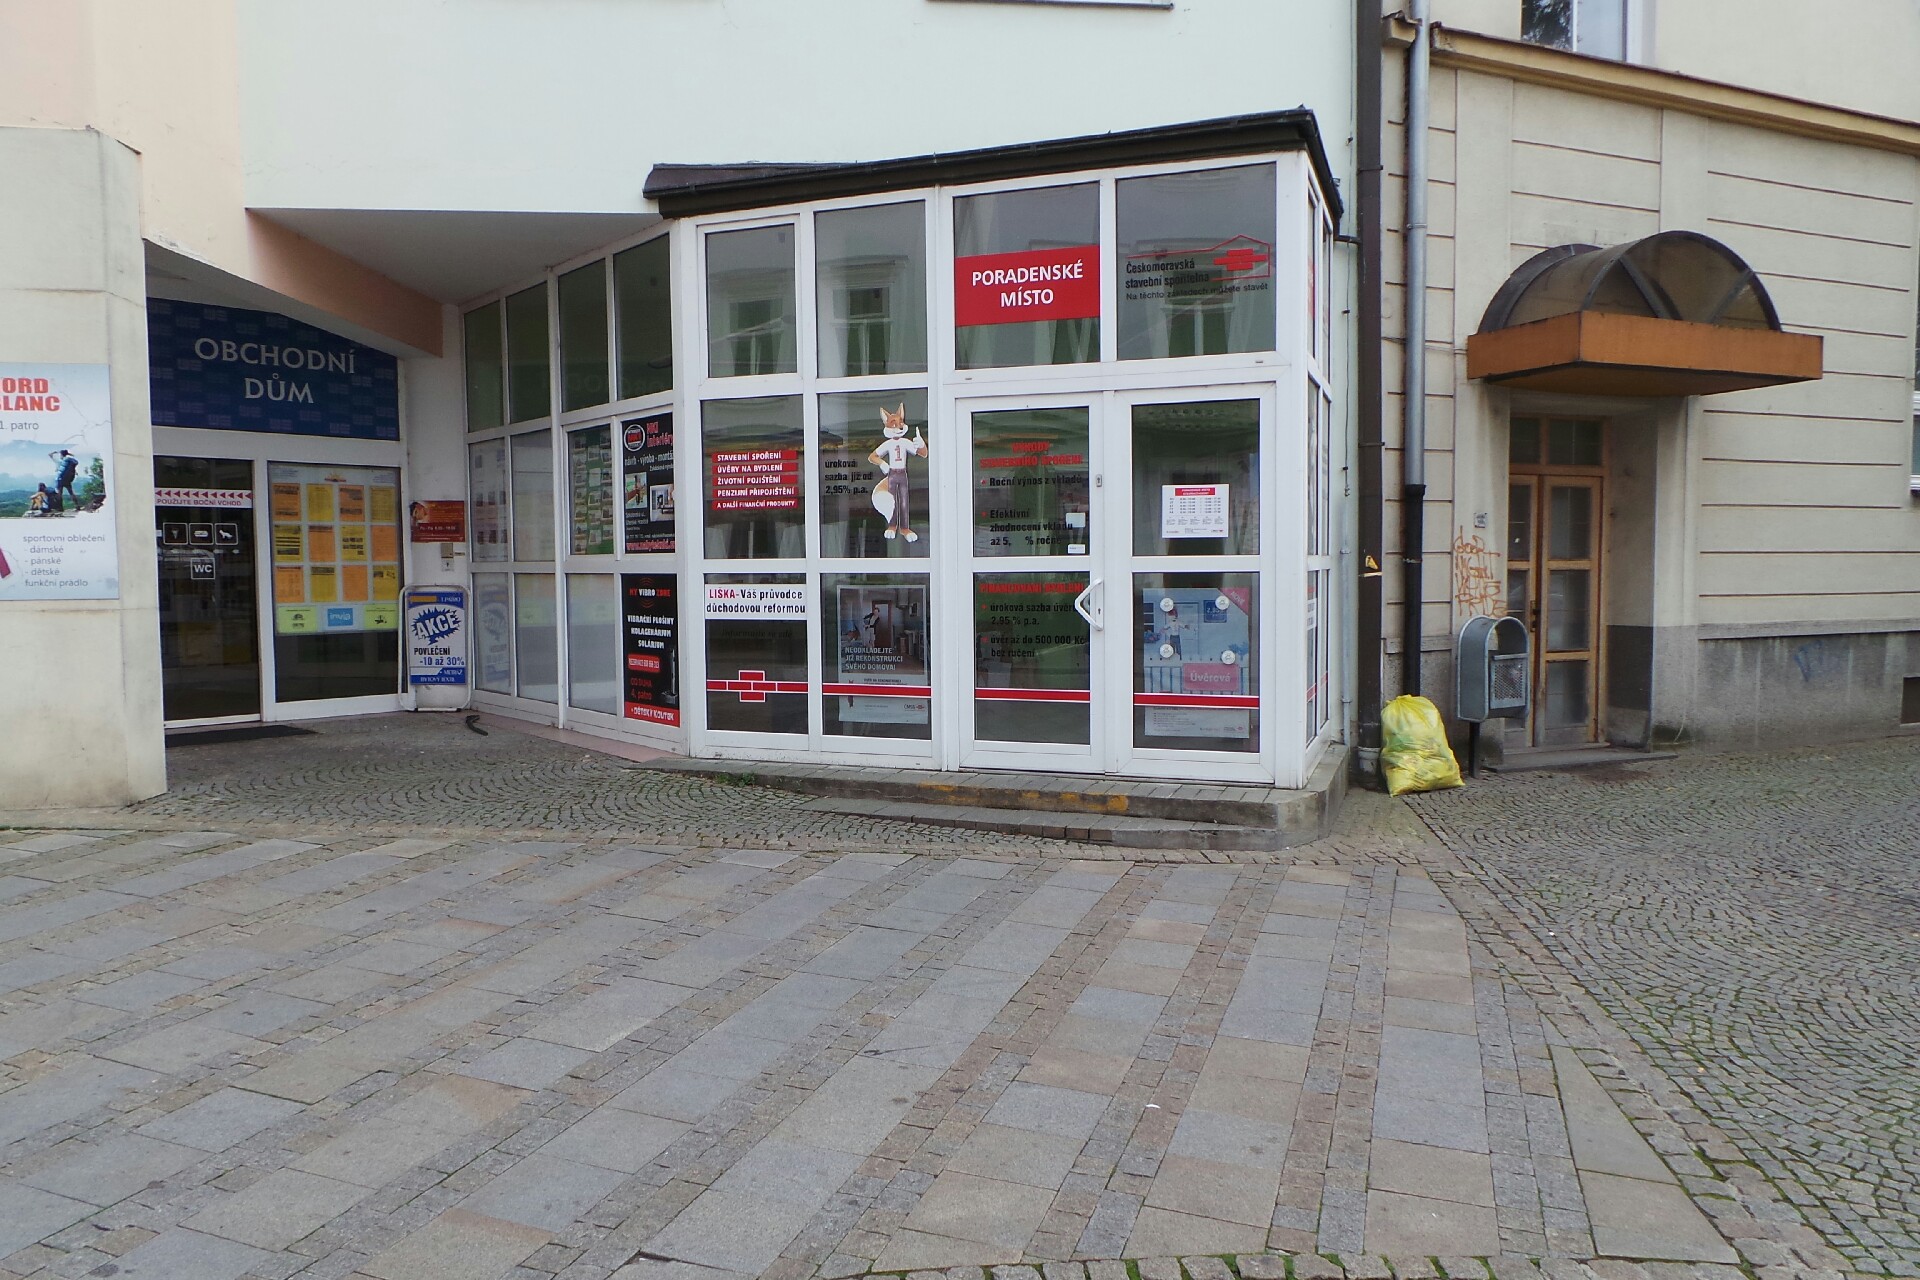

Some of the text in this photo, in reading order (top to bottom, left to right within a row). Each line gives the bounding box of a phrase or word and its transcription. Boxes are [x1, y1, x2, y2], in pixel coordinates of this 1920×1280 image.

[1126, 257, 1195, 274] Českomoravská
[972, 259, 1083, 286] PORADENSKÉ
[1125, 273, 1209, 288] stavební spořitelna
[1140, 290, 1164, 299] těchto
[1243, 283, 1268, 291] stavět
[1000, 286, 1054, 307] MÍSTO
[194, 337, 355, 374] OBCHODNÍ
[243, 373, 315, 404] DŮM
[0, 395, 60, 411] LANC
[11, 422, 39, 432] patro
[717, 450, 782, 461] STAVEBNÍ SPOŘENÍ
[717, 465, 740, 473] ÚVĚRY
[753, 462, 783, 472] BYDLENÍ
[717, 474, 781, 485] ŽIVOTNÍ POJIŠTĚNÍ
[825, 472, 873, 482] sazba již od
[989, 476, 1015, 486] Roční
[1017, 477, 1043, 487] výnos
[717, 486, 795, 497] PENZIJNÍ PŘIPOJIŠTĚNÍ
[825, 485, 869, 495] 2,95% p.a.
[722, 500, 738, 508] DALŠÍ
[739, 500, 766, 508] FINANČNÍ
[990, 508, 1030, 518] Efektivní
[990, 522, 1041, 532] zhodnocení
[23, 534, 105, 543] sportovní oblečení
[990, 537, 1001, 546] až
[1025, 536, 1034, 545] %
[29, 545, 64, 553] dámské
[30, 557, 61, 566] pánské
[30, 568, 60, 576] dětské
[194, 564, 212, 572] WC
[25, 579, 88, 588] funkční prádlo
[639, 588, 656, 596] VIBRO
[759, 588, 803, 600] průvodce
[706, 602, 806, 613] důchodovou reformou
[990, 602, 1023, 612] úroková
[1026, 603, 1051, 612] sazba
[416, 611, 457, 639] AKCE
[627, 615, 675, 626] VIBRAČNÍ PLOŠINY
[1013, 616, 1021, 625] %
[1024, 618, 1040, 627] p.a.
[630, 627, 672, 638] KOLAGENÁRIUM
[638, 639, 665, 649] SOLÁRIUM
[1010, 636, 1020, 644] až
[1022, 635, 1033, 644] do
[1035, 635, 1052, 644] 500
[1054, 635, 1071, 644] 000
[413, 645, 451, 656] POVLEČENÍ
[991, 648, 1035, 657] bez ručení
[420, 657, 465, 666] -10 až 30%
[856, 655, 903, 663] REKONSTRUKCI
[845, 662, 866, 670] SVÉHO
[1190, 670, 1231, 682] Úvěrová
